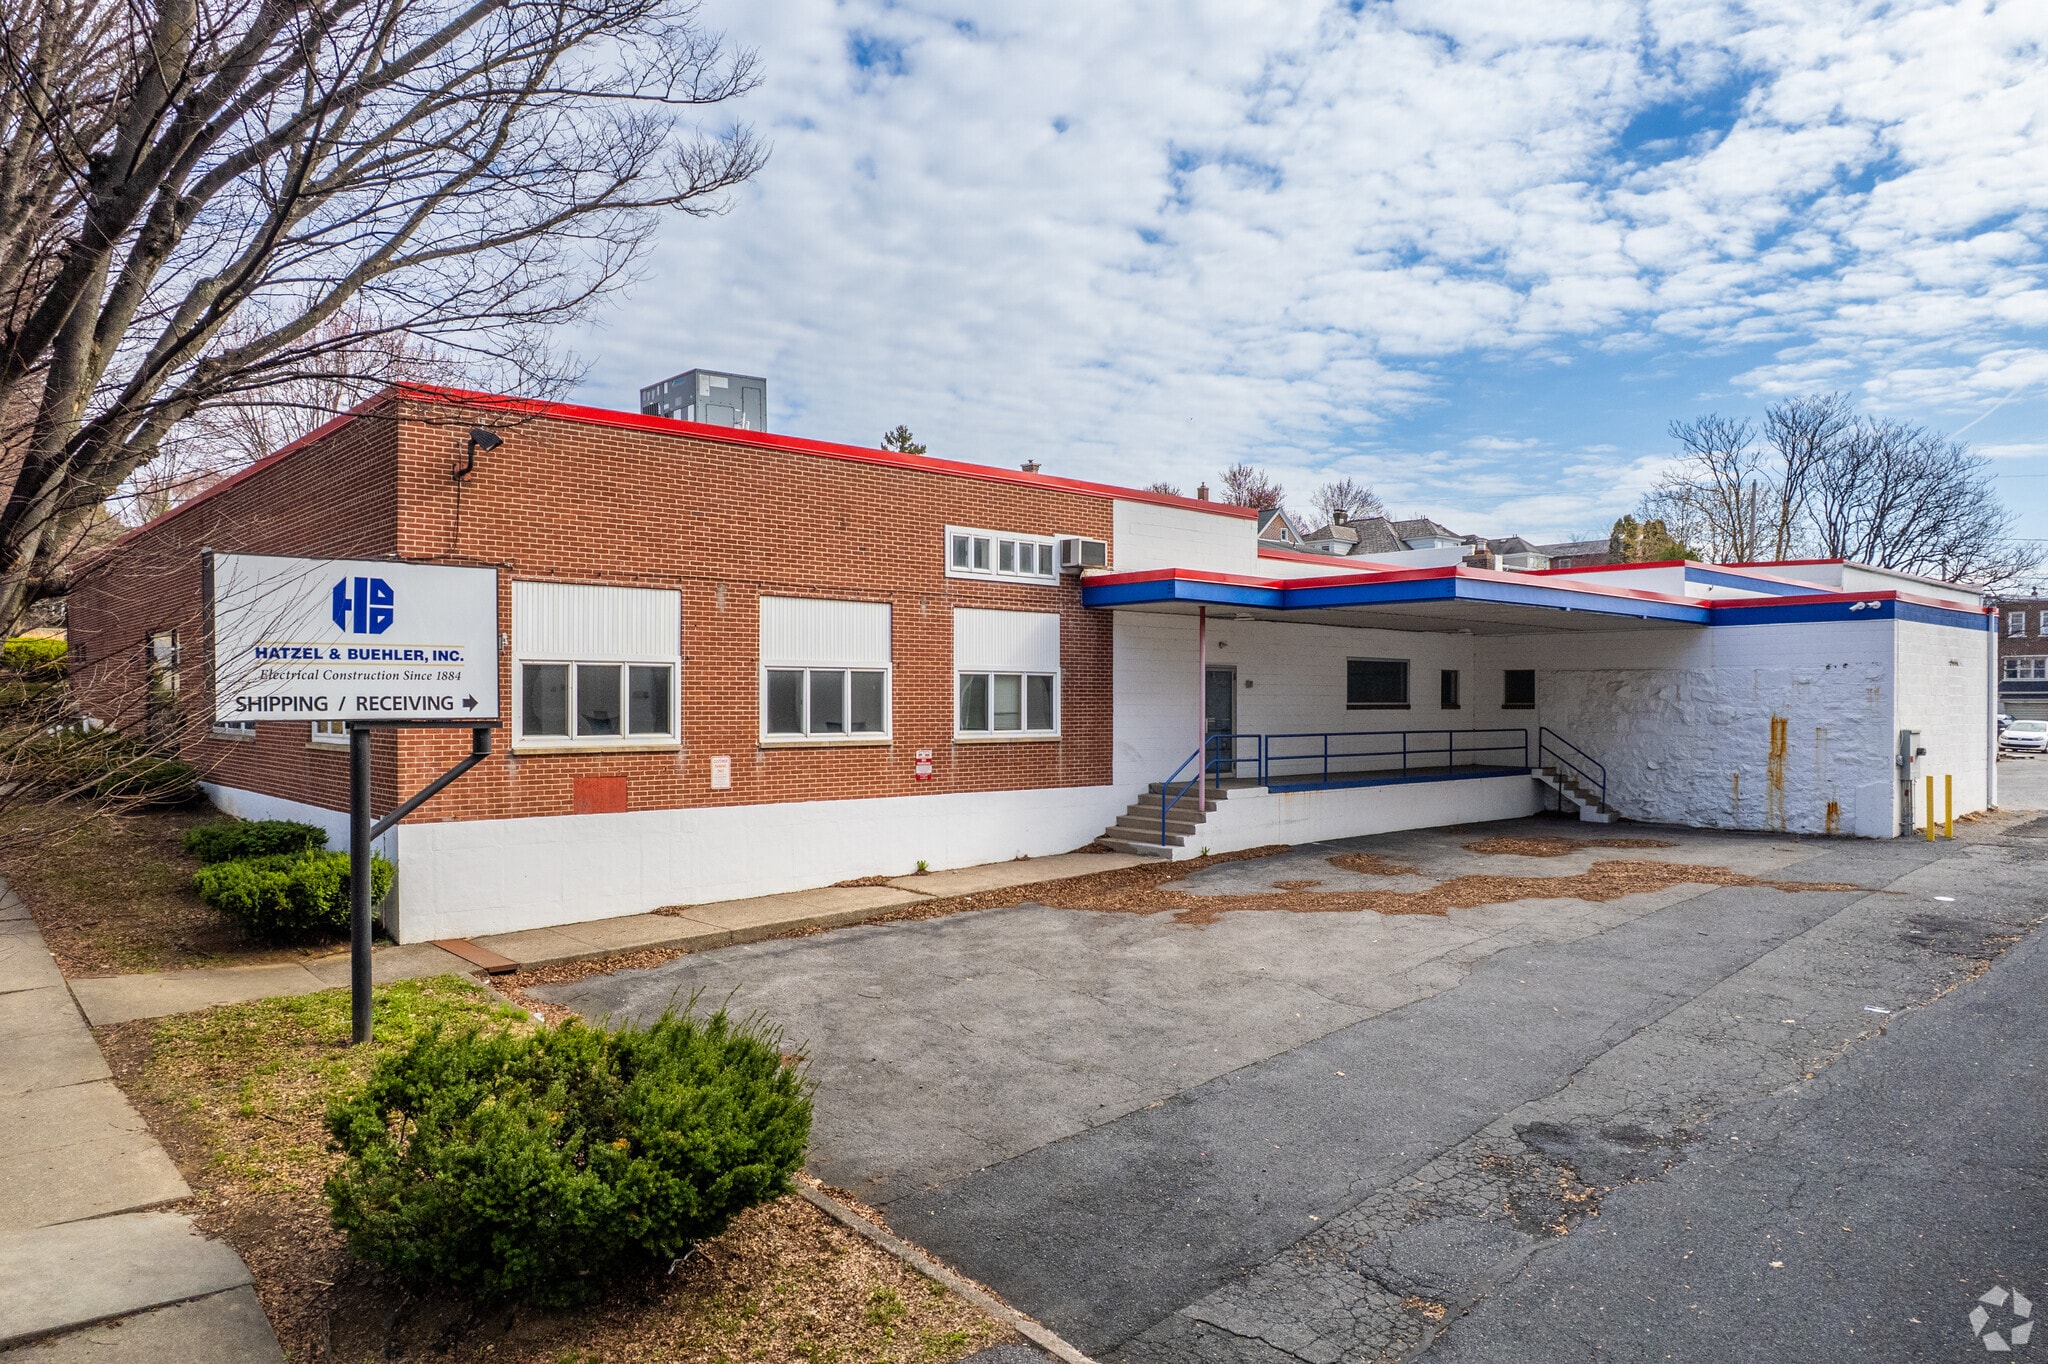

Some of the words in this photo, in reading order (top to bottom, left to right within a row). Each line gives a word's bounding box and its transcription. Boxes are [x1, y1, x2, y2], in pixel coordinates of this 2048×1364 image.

[255, 647, 323, 660] HATZEL
[329, 648, 341, 660] &
[348, 648, 429, 663] BUEHLER,
[433, 650, 464, 662] INC.
[260, 669, 319, 680] Electrical
[323, 669, 399, 681] Construction
[403, 670, 433, 681] Since
[436, 671, 461, 681] 1884
[235, 695, 328, 712] SHIPPING
[338, 696, 346, 712] /
[356, 695, 454, 712] RECEIVING
